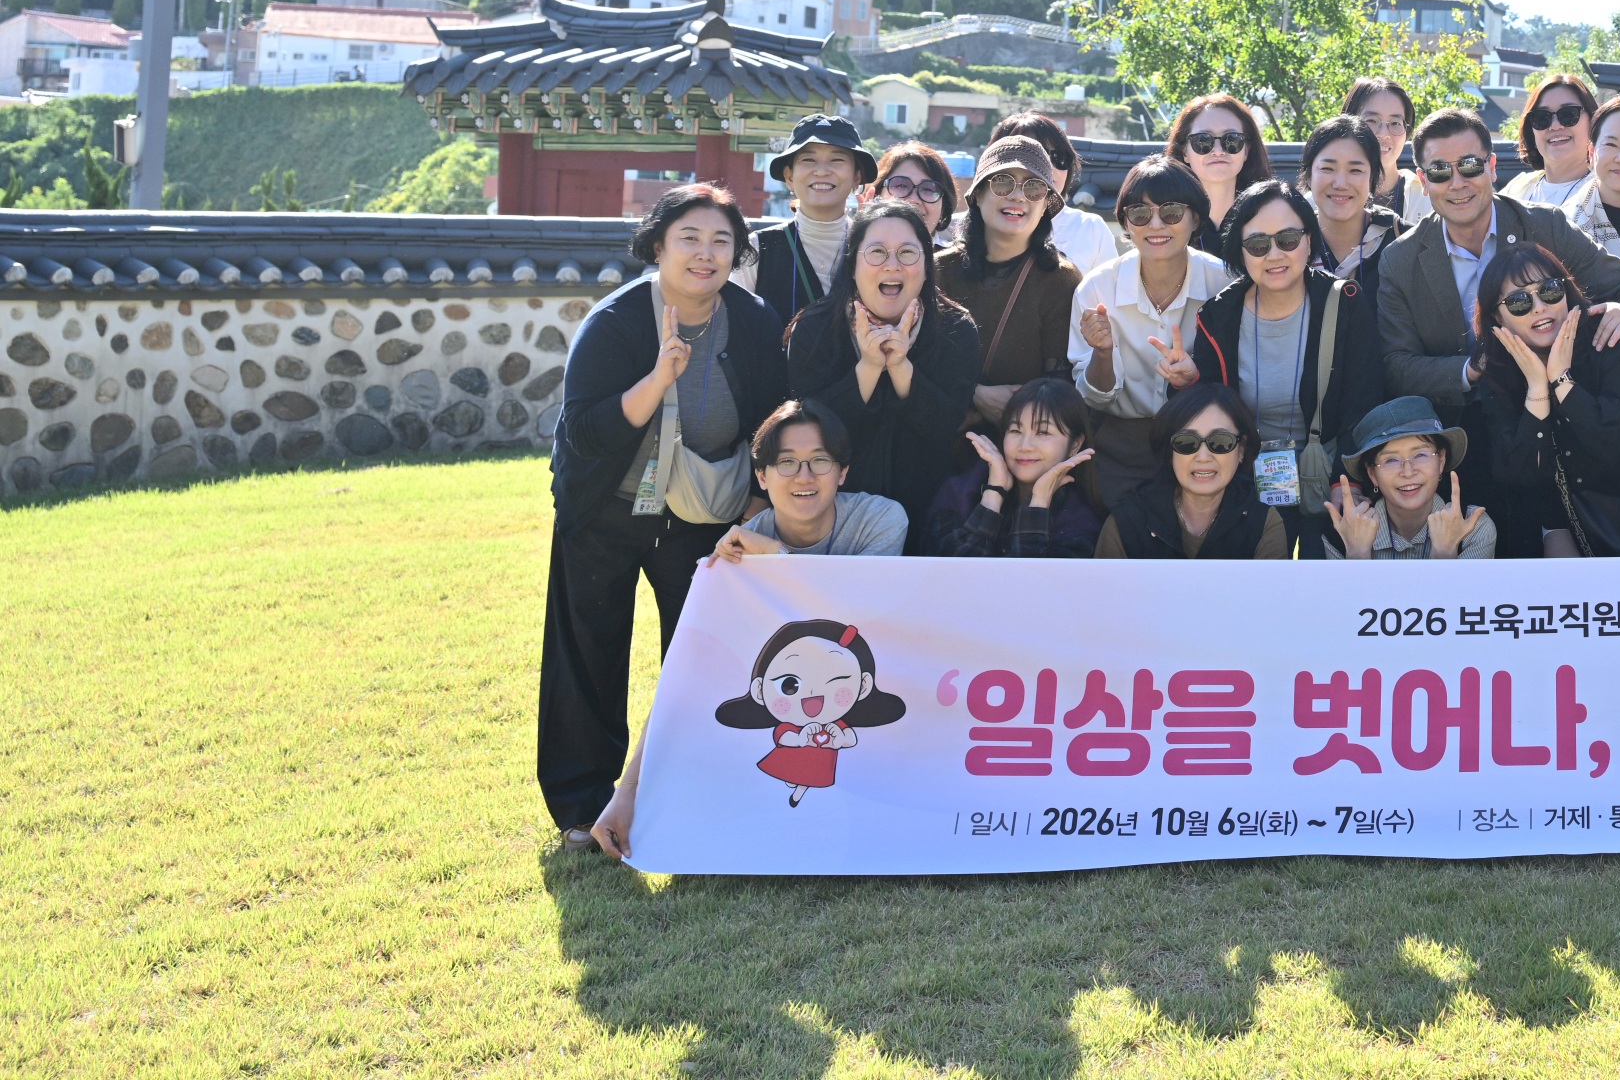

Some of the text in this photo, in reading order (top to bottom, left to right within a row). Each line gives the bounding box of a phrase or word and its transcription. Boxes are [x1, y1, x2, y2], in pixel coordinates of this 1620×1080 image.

[1358, 607, 1446, 636] 2026
[1293, 664, 1610, 779] 벗어나,
[970, 811, 1018, 837] 일시
[1040, 808, 1138, 837] 2026년
[1151, 808, 1209, 837] 10월
[1217, 807, 1298, 838] 6일(화)
[1334, 806, 1415, 835] 7일(수)
[1471, 807, 1520, 832] 장소
